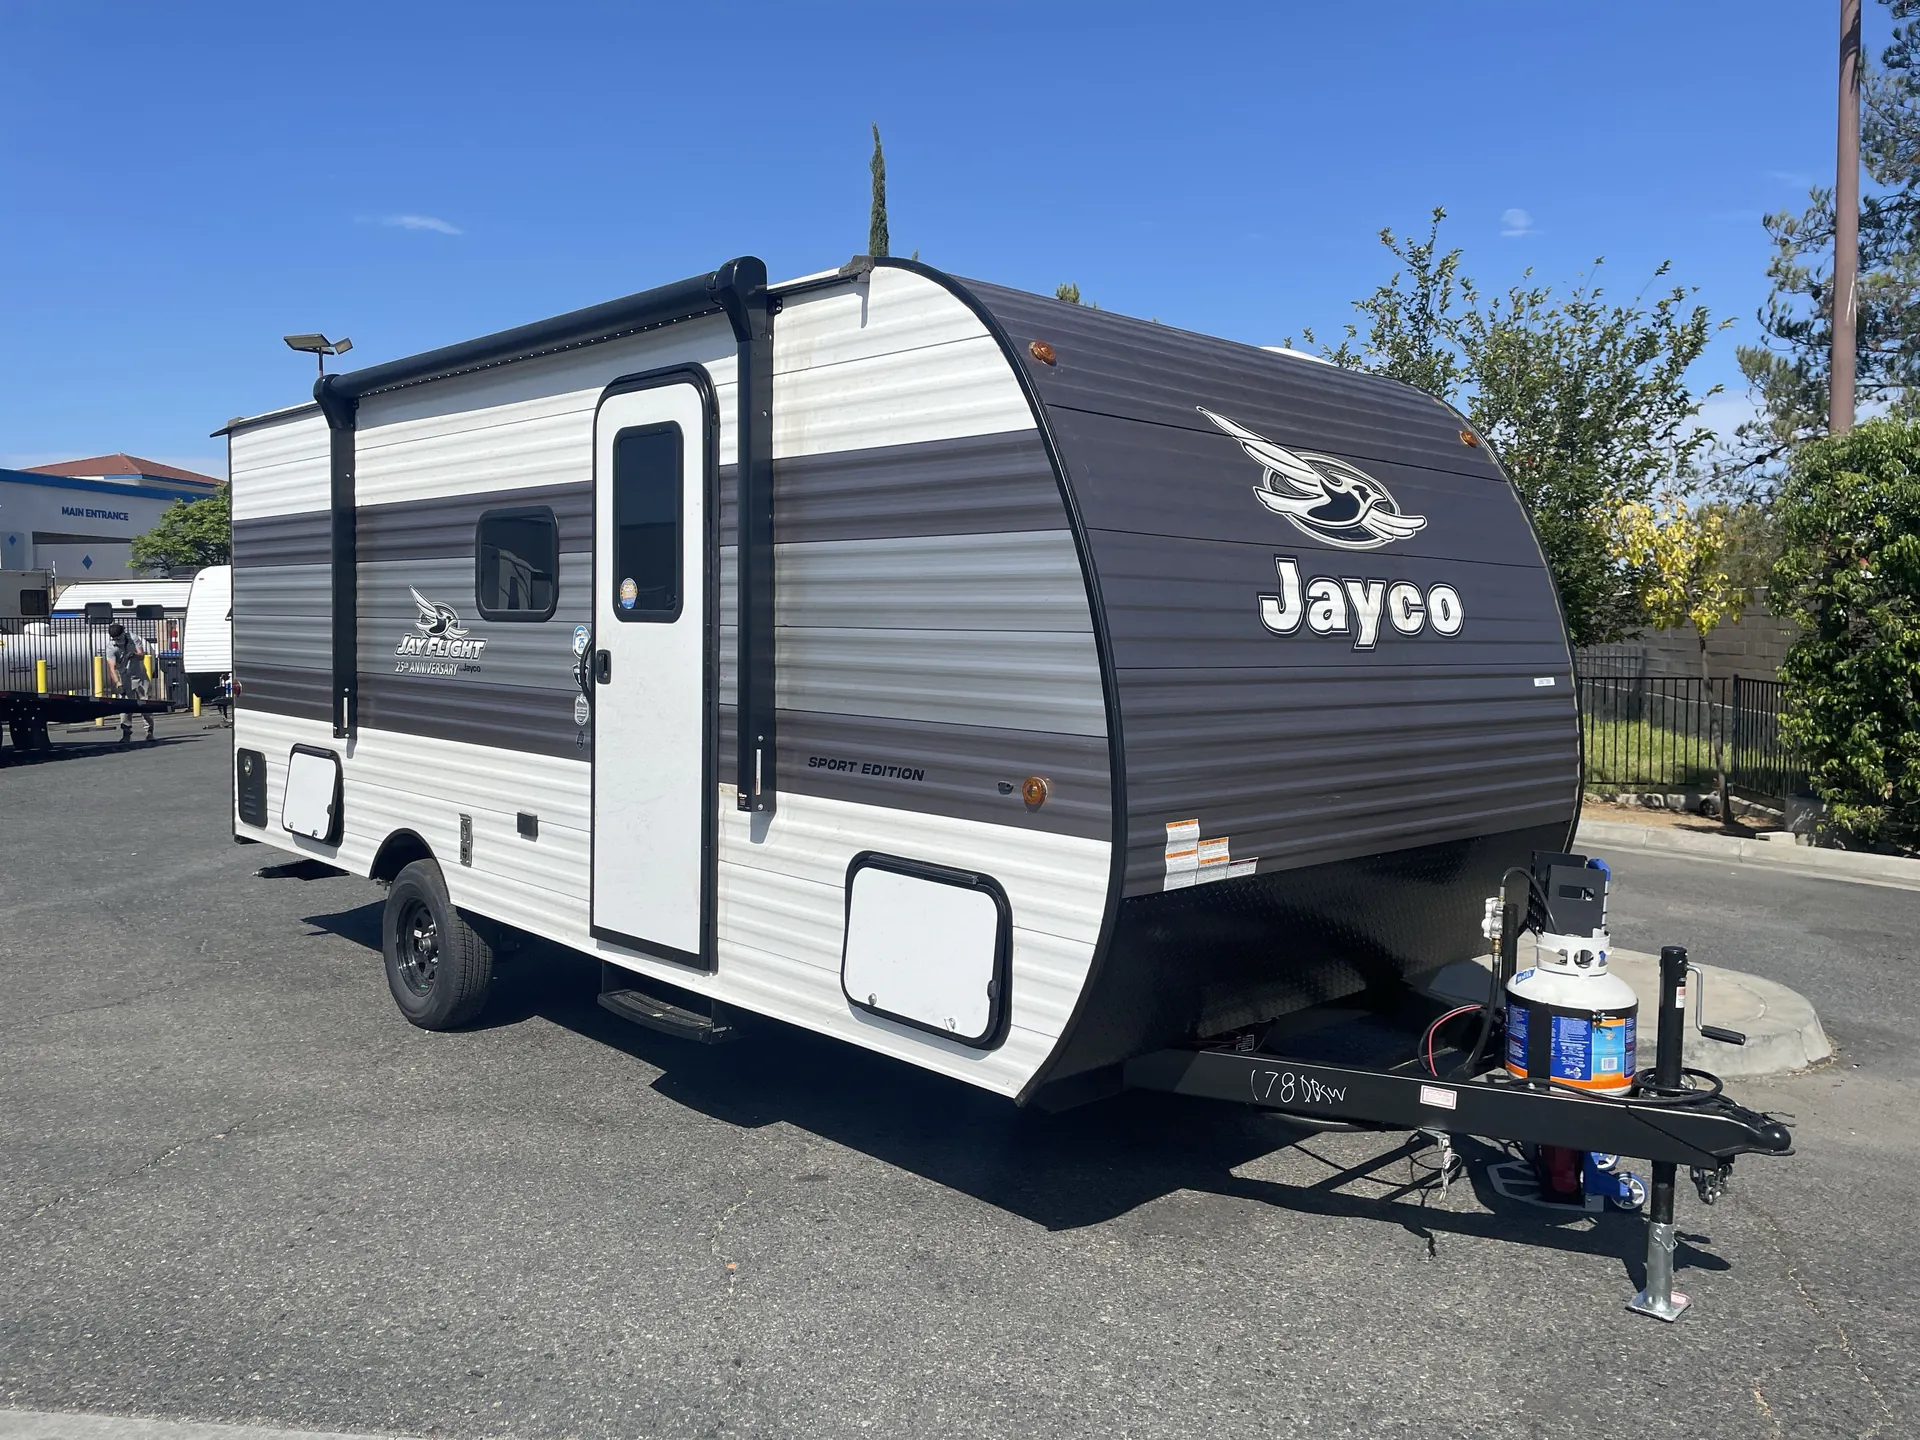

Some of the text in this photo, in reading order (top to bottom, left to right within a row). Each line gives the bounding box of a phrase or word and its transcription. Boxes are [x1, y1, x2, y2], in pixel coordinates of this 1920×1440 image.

[61, 506, 129, 521] MAIN ENTRANCE
[1257, 554, 1465, 653] Jayco
[395, 634, 486, 660] JAY FLIGHT
[409, 661, 459, 676] ANNIVERSARY
[808, 756, 925, 781] SPORT EDITION
